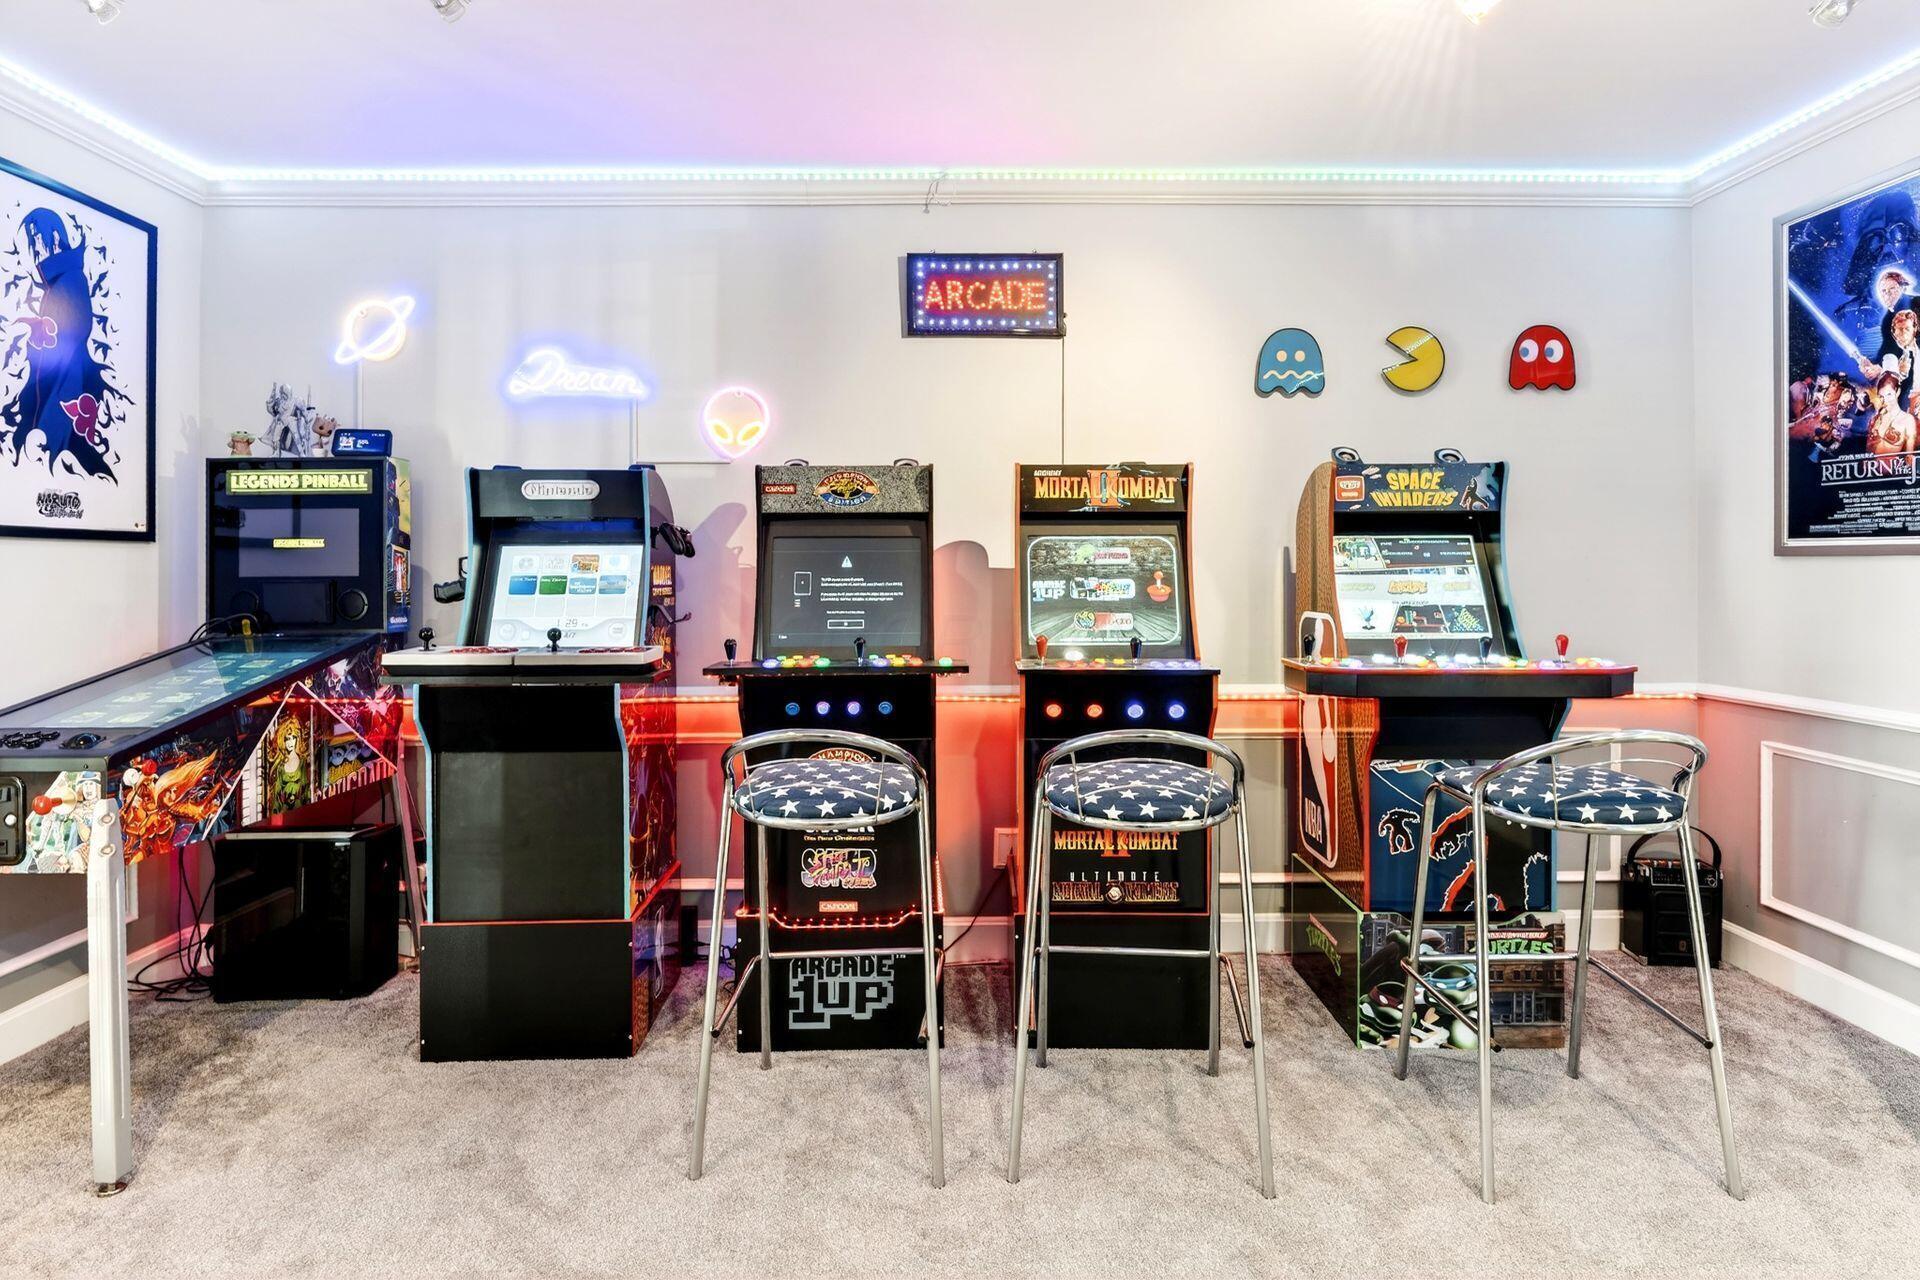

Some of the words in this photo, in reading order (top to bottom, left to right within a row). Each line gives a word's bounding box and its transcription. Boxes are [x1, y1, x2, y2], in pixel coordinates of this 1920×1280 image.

[925, 280, 1046, 310] ARCADE
[508, 349, 648, 396] Dream
[1386, 469, 1445, 490] SPACE
[1821, 460, 1896, 481] RETURN
[231, 474, 300, 489] LEGENDS
[302, 474, 367, 489] PINBALL
[530, 483, 593, 496] Nintendo
[1034, 477, 1106, 499] MORTAL
[1105, 476, 1178, 499] KOMBAT
[36, 492, 80, 509] NARUTO
[1370, 490, 1459, 507] INVADERS
[1305, 796, 1323, 844] NBA
[1054, 831, 1115, 850] MORTAL
[1116, 831, 1180, 850] KOMBAT
[1488, 938, 1554, 954] URTLES
[790, 955, 894, 980] ARCADE
[789, 975, 893, 1029] 1UP
